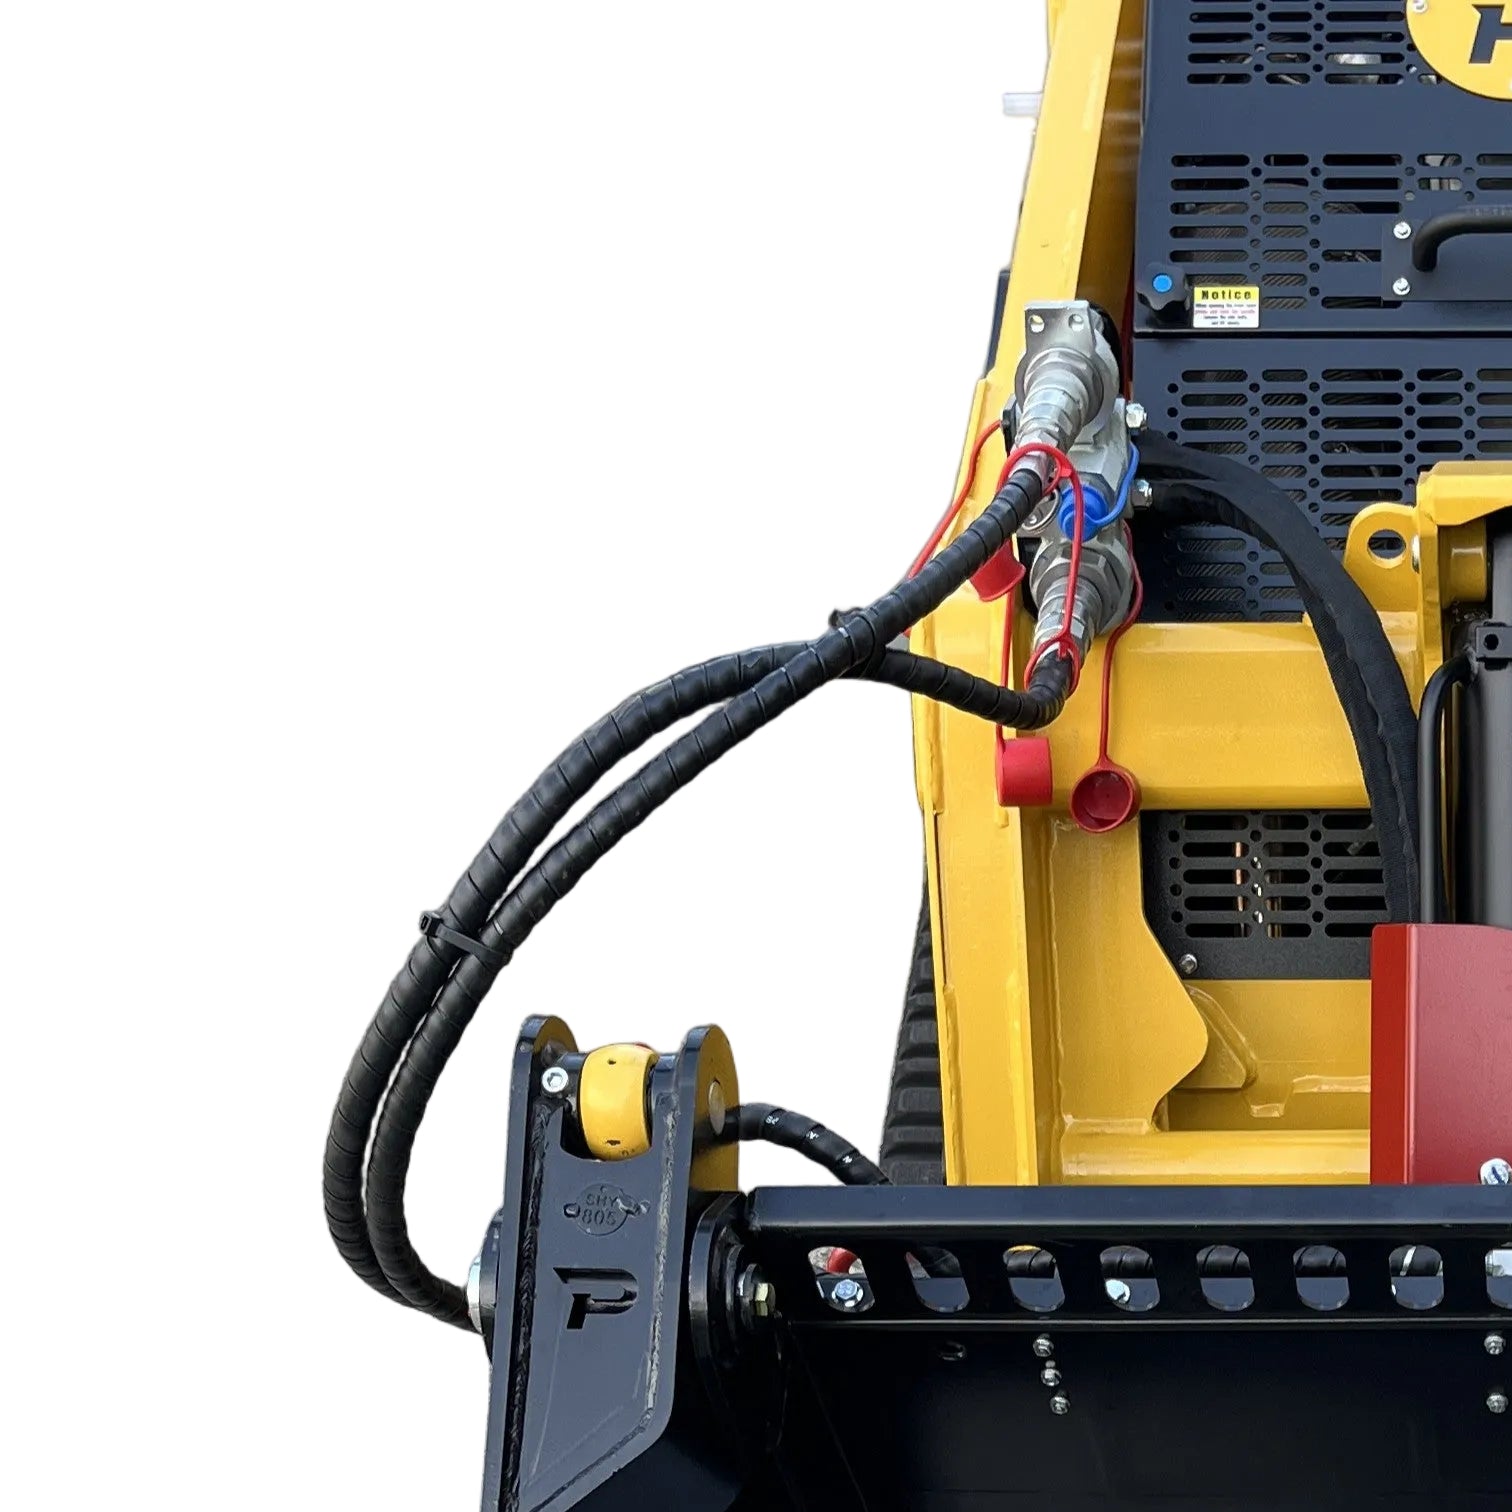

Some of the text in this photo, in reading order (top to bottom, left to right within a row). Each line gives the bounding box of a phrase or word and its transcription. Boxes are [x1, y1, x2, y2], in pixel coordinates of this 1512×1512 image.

[1201, 289, 1252, 300] Notice
[582, 1208, 617, 1225] 805
[553, 1267, 639, 1330] P
